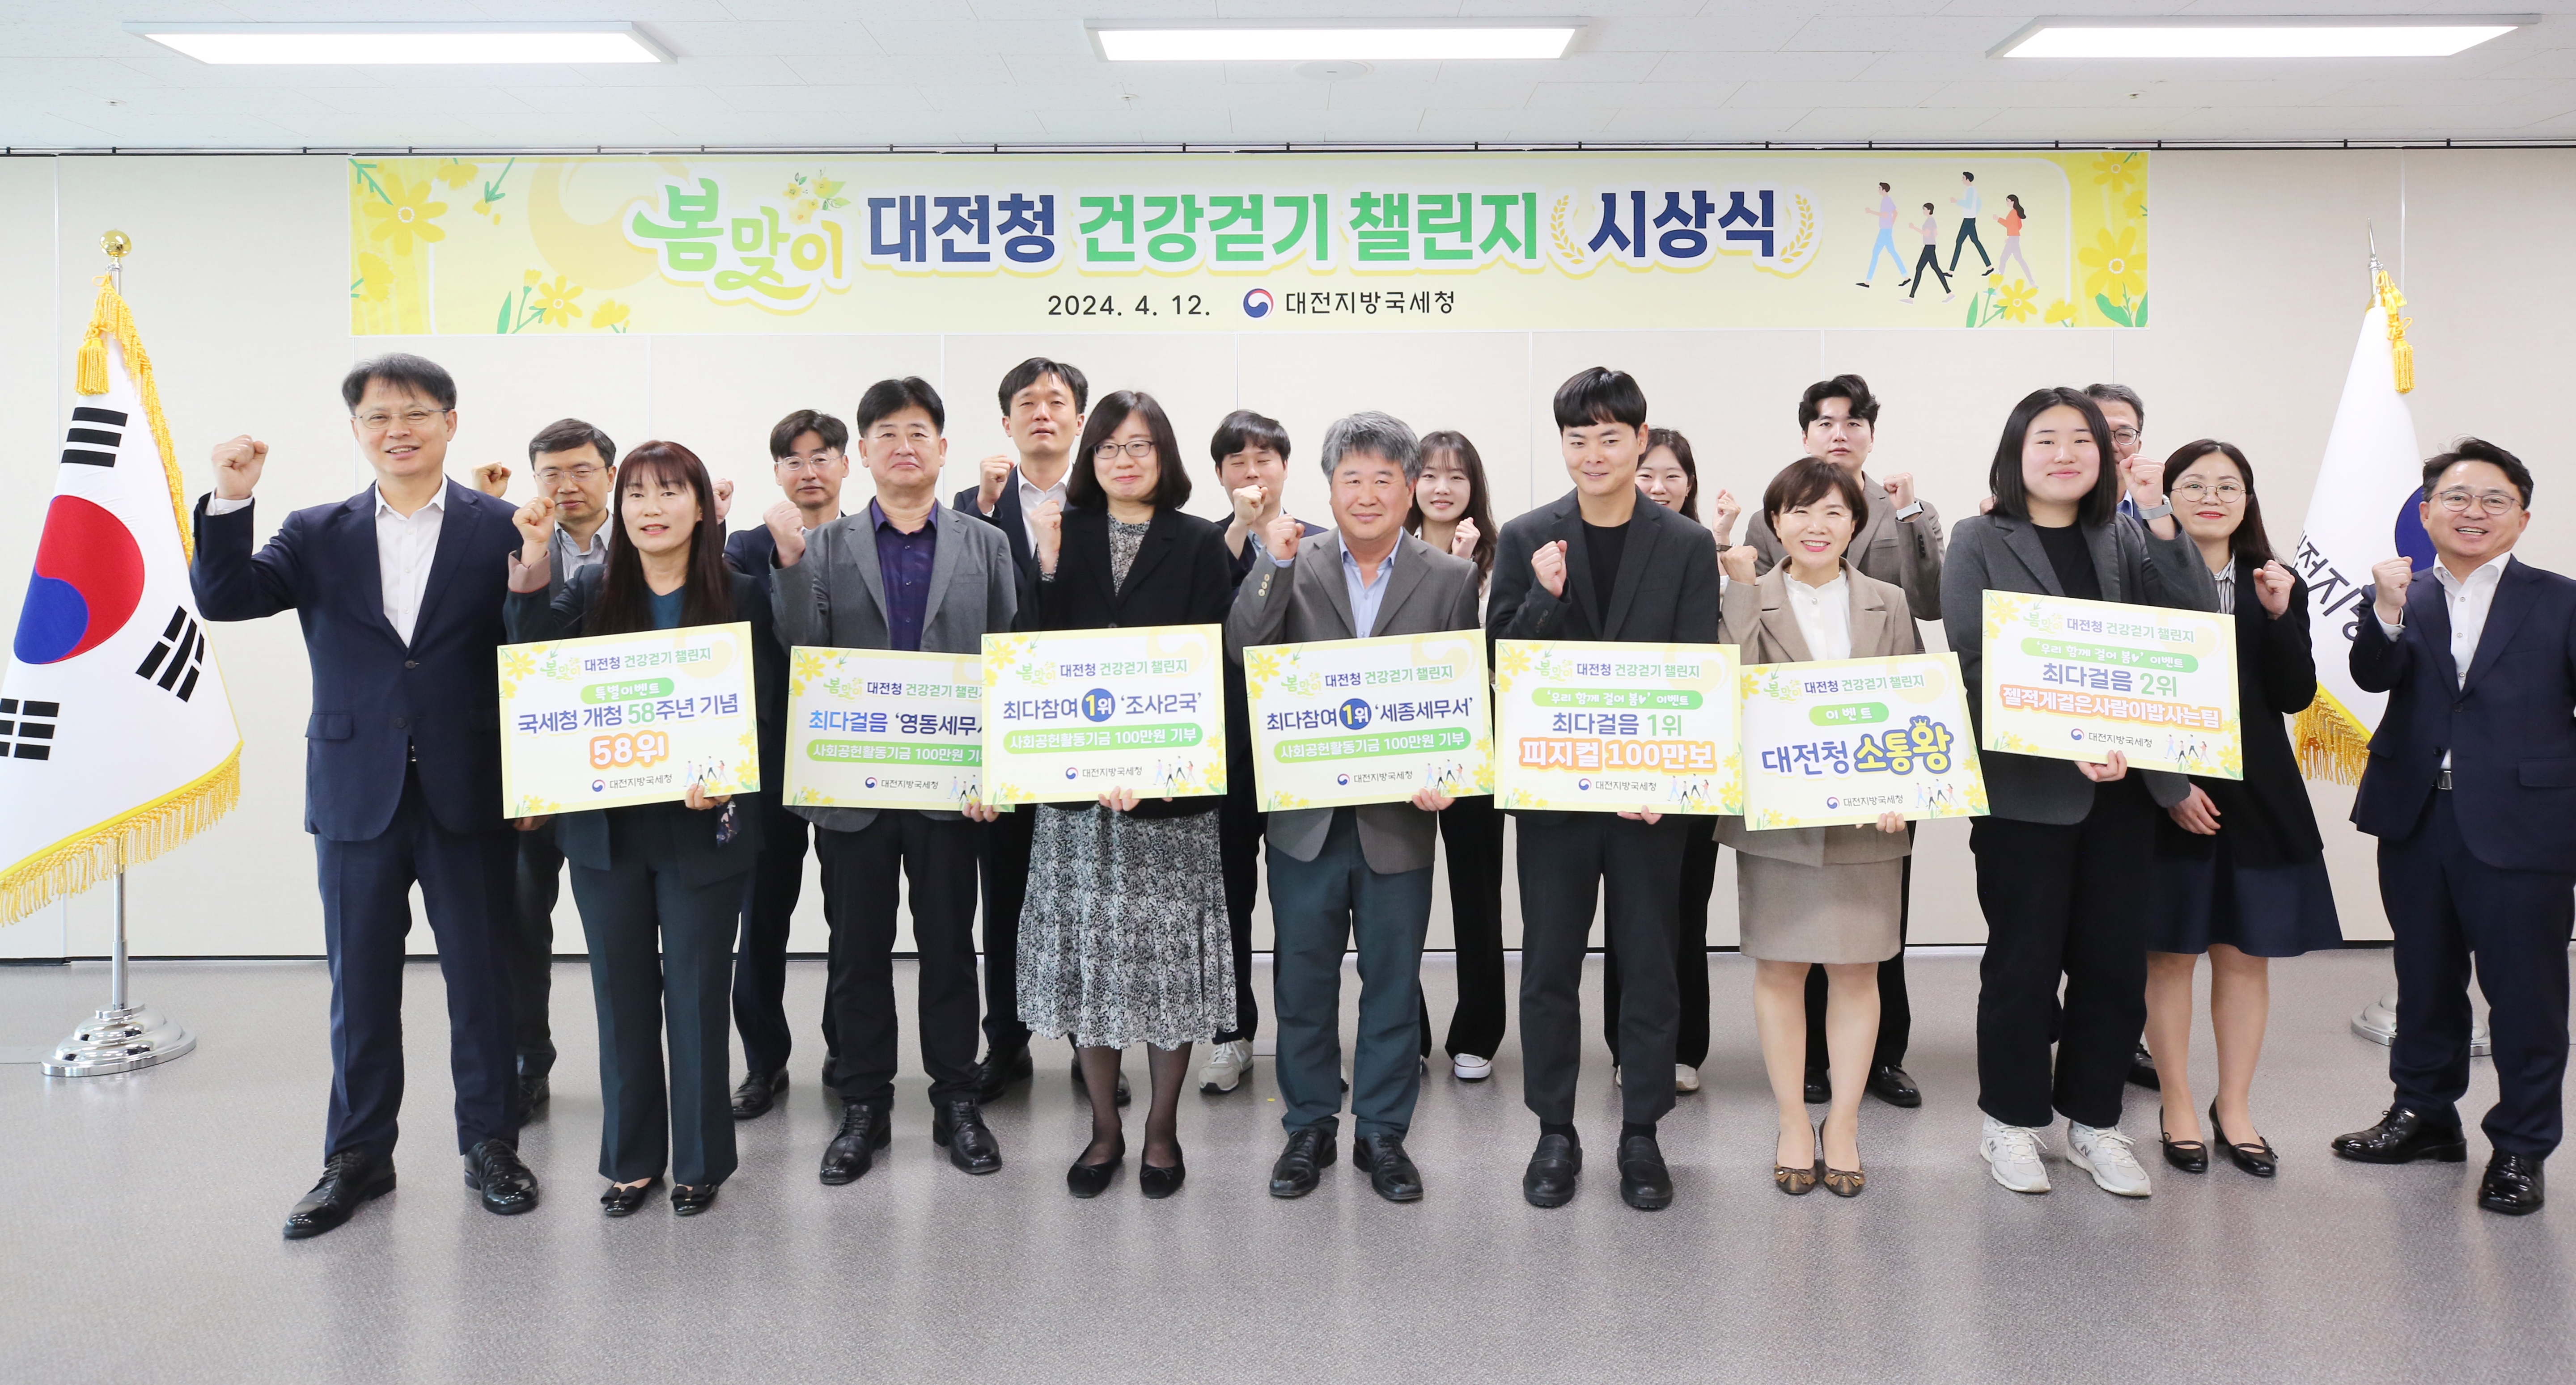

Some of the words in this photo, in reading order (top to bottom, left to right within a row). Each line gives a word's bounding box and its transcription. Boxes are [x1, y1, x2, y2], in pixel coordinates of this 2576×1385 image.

[631, 177, 843, 299] 봄맞이
[868, 192, 1056, 263] 대전청
[1078, 192, 1329, 263] 건강걷기
[1349, 190, 1537, 262] 챌린지
[1588, 189, 1775, 259] 시상식
[1048, 295, 1122, 316] 2024.
[1135, 295, 1157, 316] 4.
[1172, 295, 1210, 315] 12.
[1285, 290, 1455, 316] 대전지방국세청
[2023, 612, 2063, 633] 봄맞이
[2067, 617, 2103, 633] 대전청
[2106, 622, 2155, 638] 건강걷기
[2157, 627, 2195, 643] 챌린지
[540, 660, 580, 680] 봄맞이
[585, 656, 621, 671] 대전청
[624, 651, 672, 667] 건강걷기
[675, 647, 711, 663] 챌린지
[2066, 644, 2091, 657] 함께
[2095, 648, 2116, 661] 걸어
[2150, 656, 2183, 668] 이벤트
[1016, 663, 1056, 685] 봄맞이
[1060, 663, 1096, 677] 대전청
[1099, 661, 1148, 676] 건강걷기
[1151, 659, 1187, 673] 챌린지
[1281, 675, 1322, 697] 봄맞이
[1325, 672, 1361, 688] 대전청
[1364, 668, 1413, 685] 건강걷기
[1416, 664, 1453, 680] 챌린지
[1534, 660, 1572, 681] 봄맞이
[1577, 663, 1611, 676] 대전청
[1615, 664, 1661, 678] 건강걷기
[1664, 664, 1700, 678] 챌린지
[2042, 663, 2132, 692] 최다걸음
[2140, 672, 2178, 697] 2위
[595, 682, 660, 701] 특별이벤트
[823, 678, 863, 700] 봄맞이
[867, 681, 902, 696] 대전청
[906, 683, 952, 698] 건강걷기
[1575, 692, 1600, 705] 함께
[1603, 692, 1624, 705] 걸어
[1657, 694, 1689, 706] 이벤트
[1764, 682, 1802, 702] 봄맞이
[1805, 680, 1839, 694] 대전청
[1842, 677, 1887, 692] 건강걷기
[1890, 675, 1924, 688] 챌린지
[518, 709, 578, 733] 국세청
[584, 705, 622, 728] 개청
[628, 697, 695, 724] 58주년
[700, 693, 738, 715] 기념
[1003, 698, 1078, 720] 최다참여
[1085, 694, 1113, 716] 1위
[1121, 692, 1202, 714] ‘조사2국’
[1267, 708, 1338, 731] 최다참여
[1342, 705, 1369, 725] 1위
[1375, 697, 1473, 722] ‘세종세무서’
[2003, 686, 2219, 728] 젤적게걸은사람이밥사는팀
[809, 710, 888, 733] 최다걸음
[895, 712, 982, 736] ‘영동세무
[1552, 713, 1640, 735] 최다걸음
[1648, 714, 1682, 736] 1위
[594, 734, 665, 765] 58위
[1010, 731, 1111, 749] 사회공헌활동기금
[1115, 729, 1165, 744] 100만원
[1170, 727, 1196, 742] 기부
[1281, 739, 1380, 759] 사회공헌활동기금
[1384, 735, 1434, 751] 100만원
[1439, 732, 1465, 747] 기부
[1762, 740, 1850, 775] 대전청
[1856, 725, 1952, 773] 소통왕
[2089, 732, 2152, 748] 대전지방국세청
[813, 744, 911, 761] 사회공헌활동기금
[915, 747, 963, 762] 100만원
[968, 750, 982, 762] 기
[1522, 740, 1600, 768] 피지컬
[1609, 743, 1714, 769] 100만보
[610, 773, 672, 789] 대전지방국세청
[881, 779, 939, 790] 대전지방국세청
[1082, 766, 1142, 778] 대전지방국세청
[1354, 771, 1413, 783] 대전지방국세청
[1595, 781, 1657, 791] 대전지방국세청
[1843, 795, 1903, 807] 대전지방국세청
